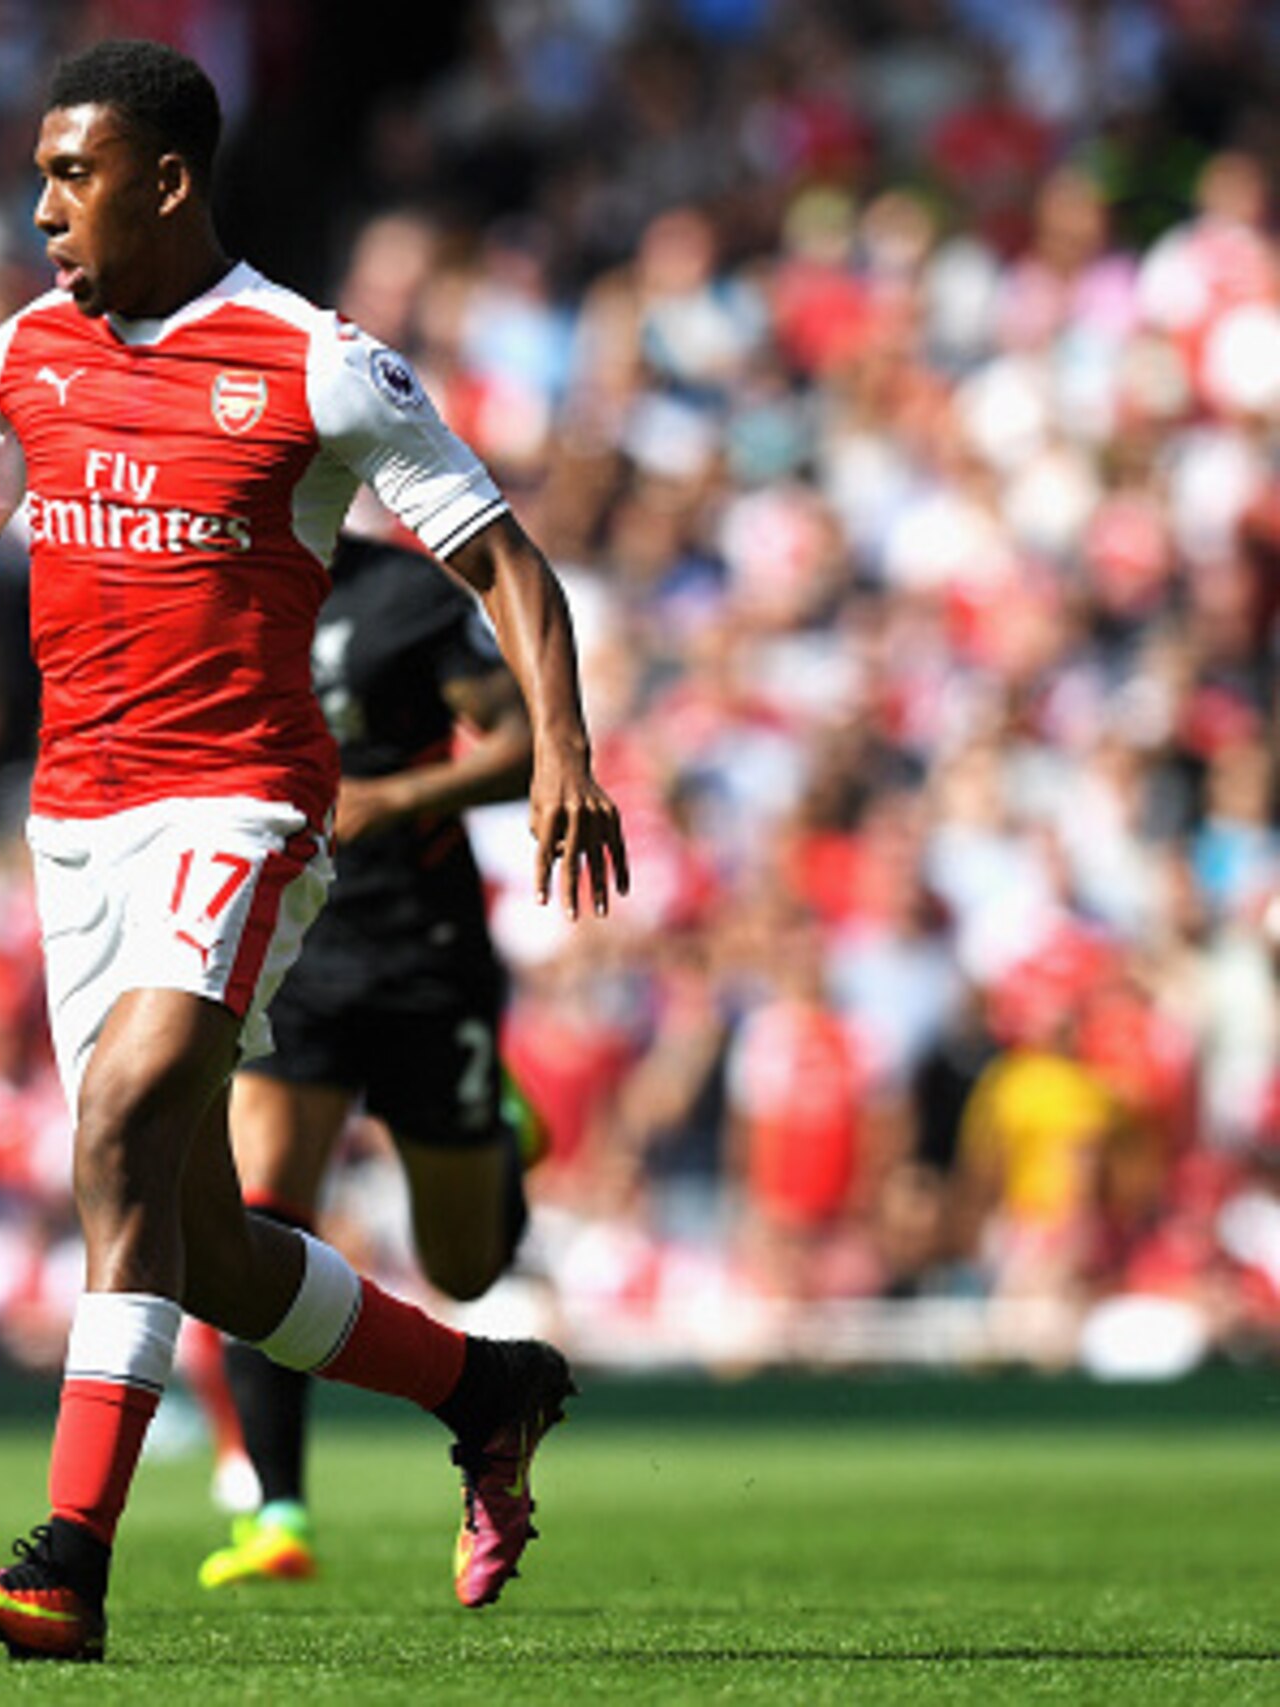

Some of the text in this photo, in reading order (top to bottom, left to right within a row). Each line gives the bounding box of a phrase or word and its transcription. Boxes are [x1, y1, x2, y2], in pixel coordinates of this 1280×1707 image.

[84, 449, 158, 502] Fly
[23, 490, 252, 555] Emirates
[169, 849, 251, 919] 17
